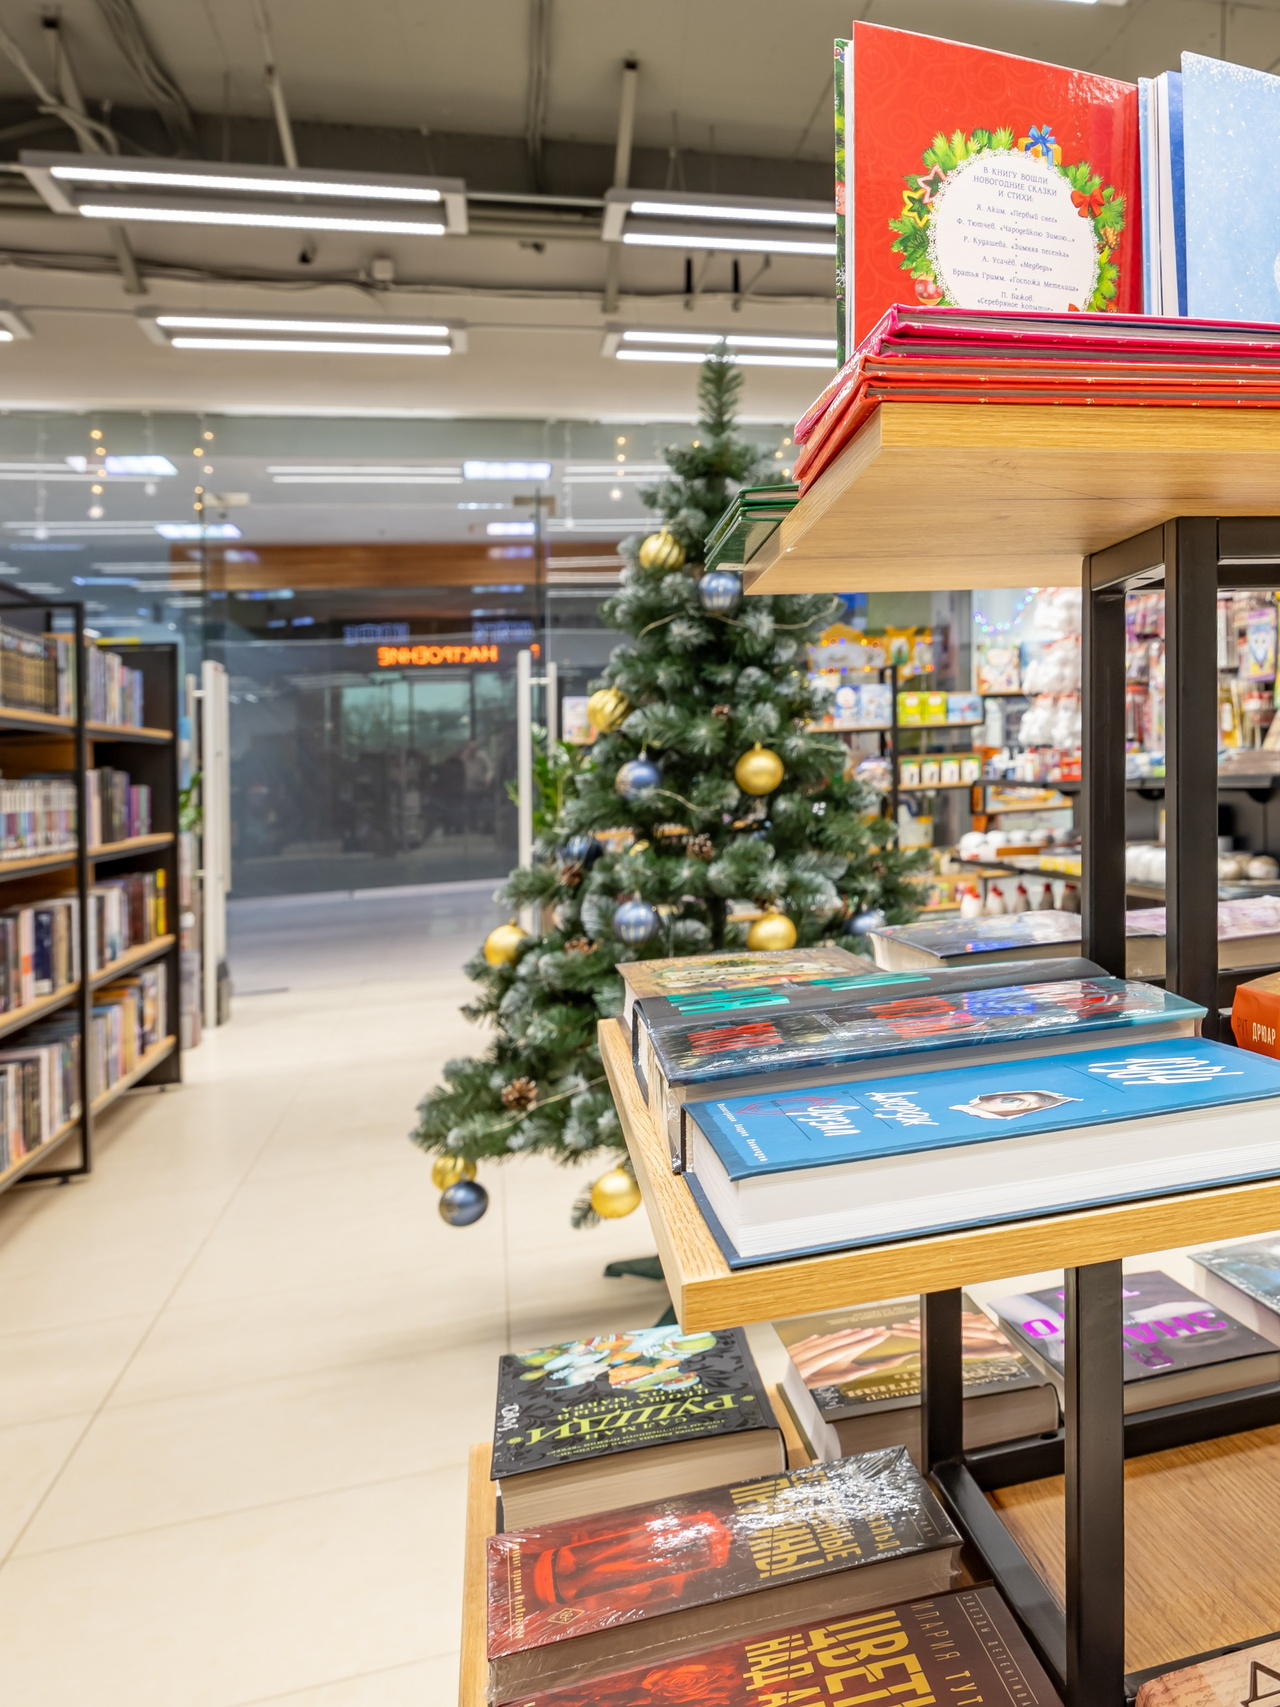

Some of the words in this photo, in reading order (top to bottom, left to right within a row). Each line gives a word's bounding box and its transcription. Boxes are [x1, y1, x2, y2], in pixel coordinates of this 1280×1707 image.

[983, 166, 988, 174] В
[991, 168, 1017, 179] КНИГУ
[1020, 173, 1048, 185] ВОШЛИ
[973, 175, 1025, 191] НОВОГОДНИЕ
[1027, 185, 1057, 197] СКАЗКИ
[998, 189, 1003, 197] И
[1006, 191, 1034, 203] СТИХИ:
[976, 203, 984, 211] Я.
[1010, 209, 1038, 221] «Первый
[956, 217, 965, 226] Ф.
[967, 219, 997, 230] Тютчев.
[963, 236, 970, 244] Р.
[972, 237, 1008, 249] Кудашева.
[1041, 247, 1069, 258] песенка»
[981, 255, 990, 263] А.
[1020, 261, 1053, 272] «Медведь»
[952, 268, 980, 279] Братья
[982, 271, 1006, 282] Гримм.
[1009, 275, 1041, 287] «Госпожа
[977, 297, 1019, 309] «Серебряное
[1001, 291, 1009, 299] П.
[1011, 292, 1035, 302] Бажов.
[1236, 1016, 1248, 1036] РУТ
[1252, 1022, 1276, 1046] ДРЮАР
[525, 1393, 739, 1446] РУШДИ
[584, 1416, 688, 1440] САЛМАН
[742, 1633, 815, 1691] НАД
[910, 1601, 961, 1662] ИЛАРИЯ
[945, 1670, 984, 1706] ТУТ
[986, 1640, 1032, 1706] ДЕТЕКТИВА
